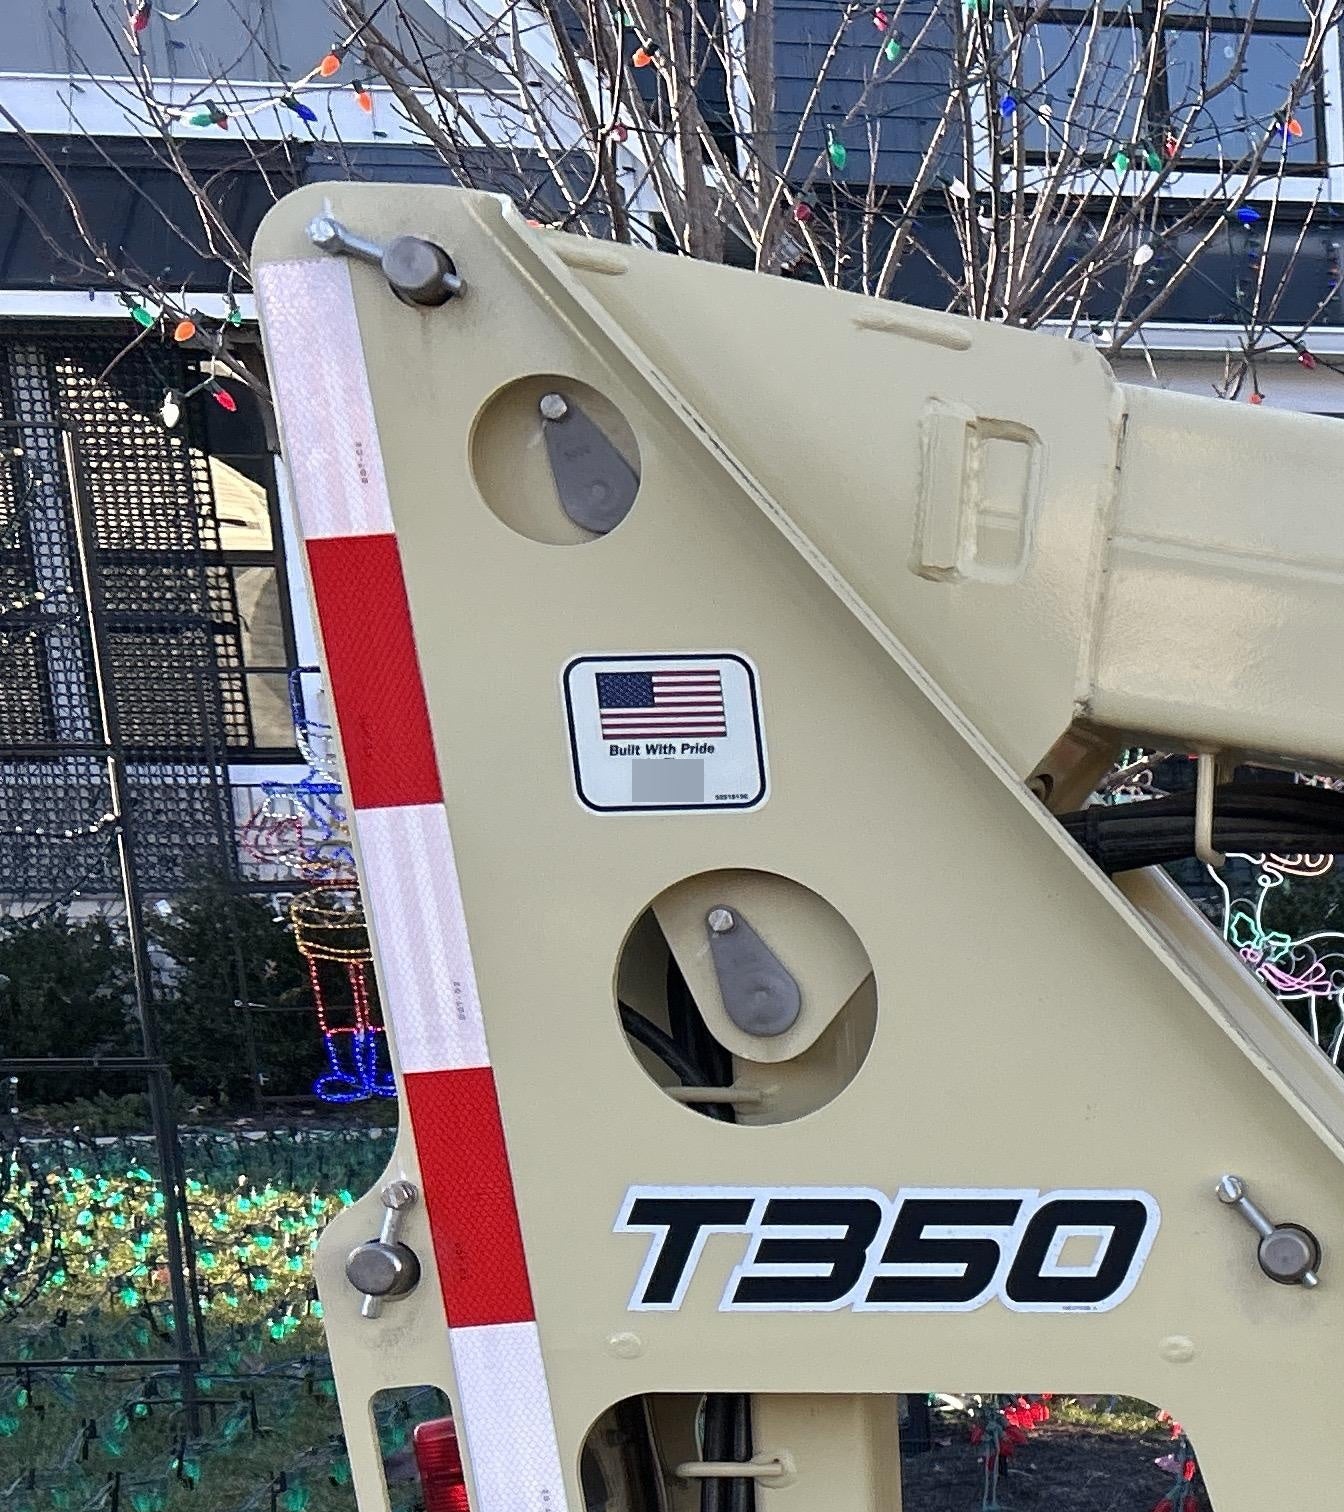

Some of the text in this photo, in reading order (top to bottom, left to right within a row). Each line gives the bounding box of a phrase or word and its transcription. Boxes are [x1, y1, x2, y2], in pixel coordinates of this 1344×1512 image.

[609, 742, 715, 756] Built With Pride
[626, 1199, 1148, 1304] T350
